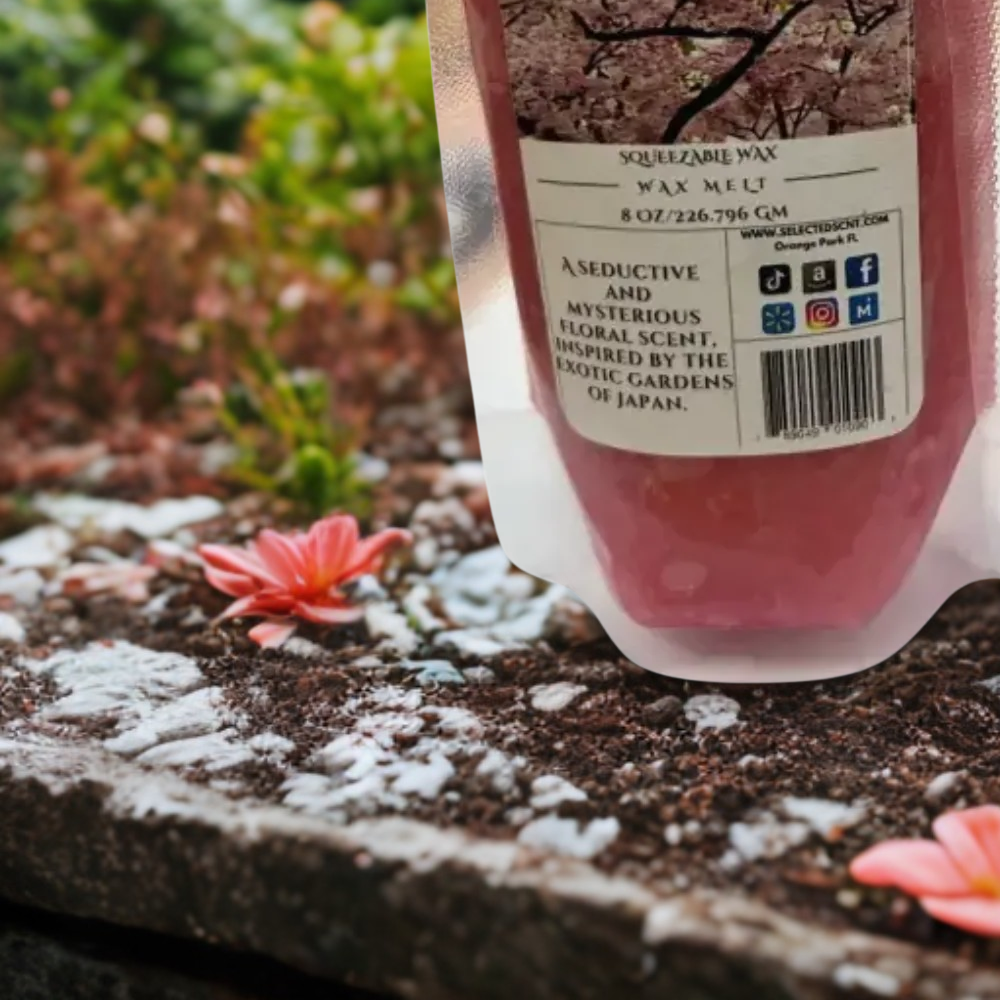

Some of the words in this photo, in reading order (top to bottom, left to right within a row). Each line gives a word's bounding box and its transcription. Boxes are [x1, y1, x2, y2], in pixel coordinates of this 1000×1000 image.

[736, 144, 778, 165] WAX
[637, 178, 689, 197] WAX
[703, 177, 766, 195] MELT
[621, 207, 632, 223] 8
[754, 204, 788, 222] GM
[774, 240, 816, 252] Orange
[819, 235, 845, 247] Park
[562, 256, 578, 277] A
[577, 259, 700, 281] SEDUCTIVE
[604, 284, 652, 302] AND
[567, 300, 702, 325] MYSTERIOUS
[559, 319, 633, 344] FLORAL
[555, 337, 643, 366] INSPIRED
[650, 353, 676, 368] BY
[683, 353, 729, 368] THE
[556, 356, 623, 385] EXOTIC
[627, 372, 735, 390] GARDENS
[587, 385, 612, 402] OF
[617, 391, 688, 412] JAPAN.
